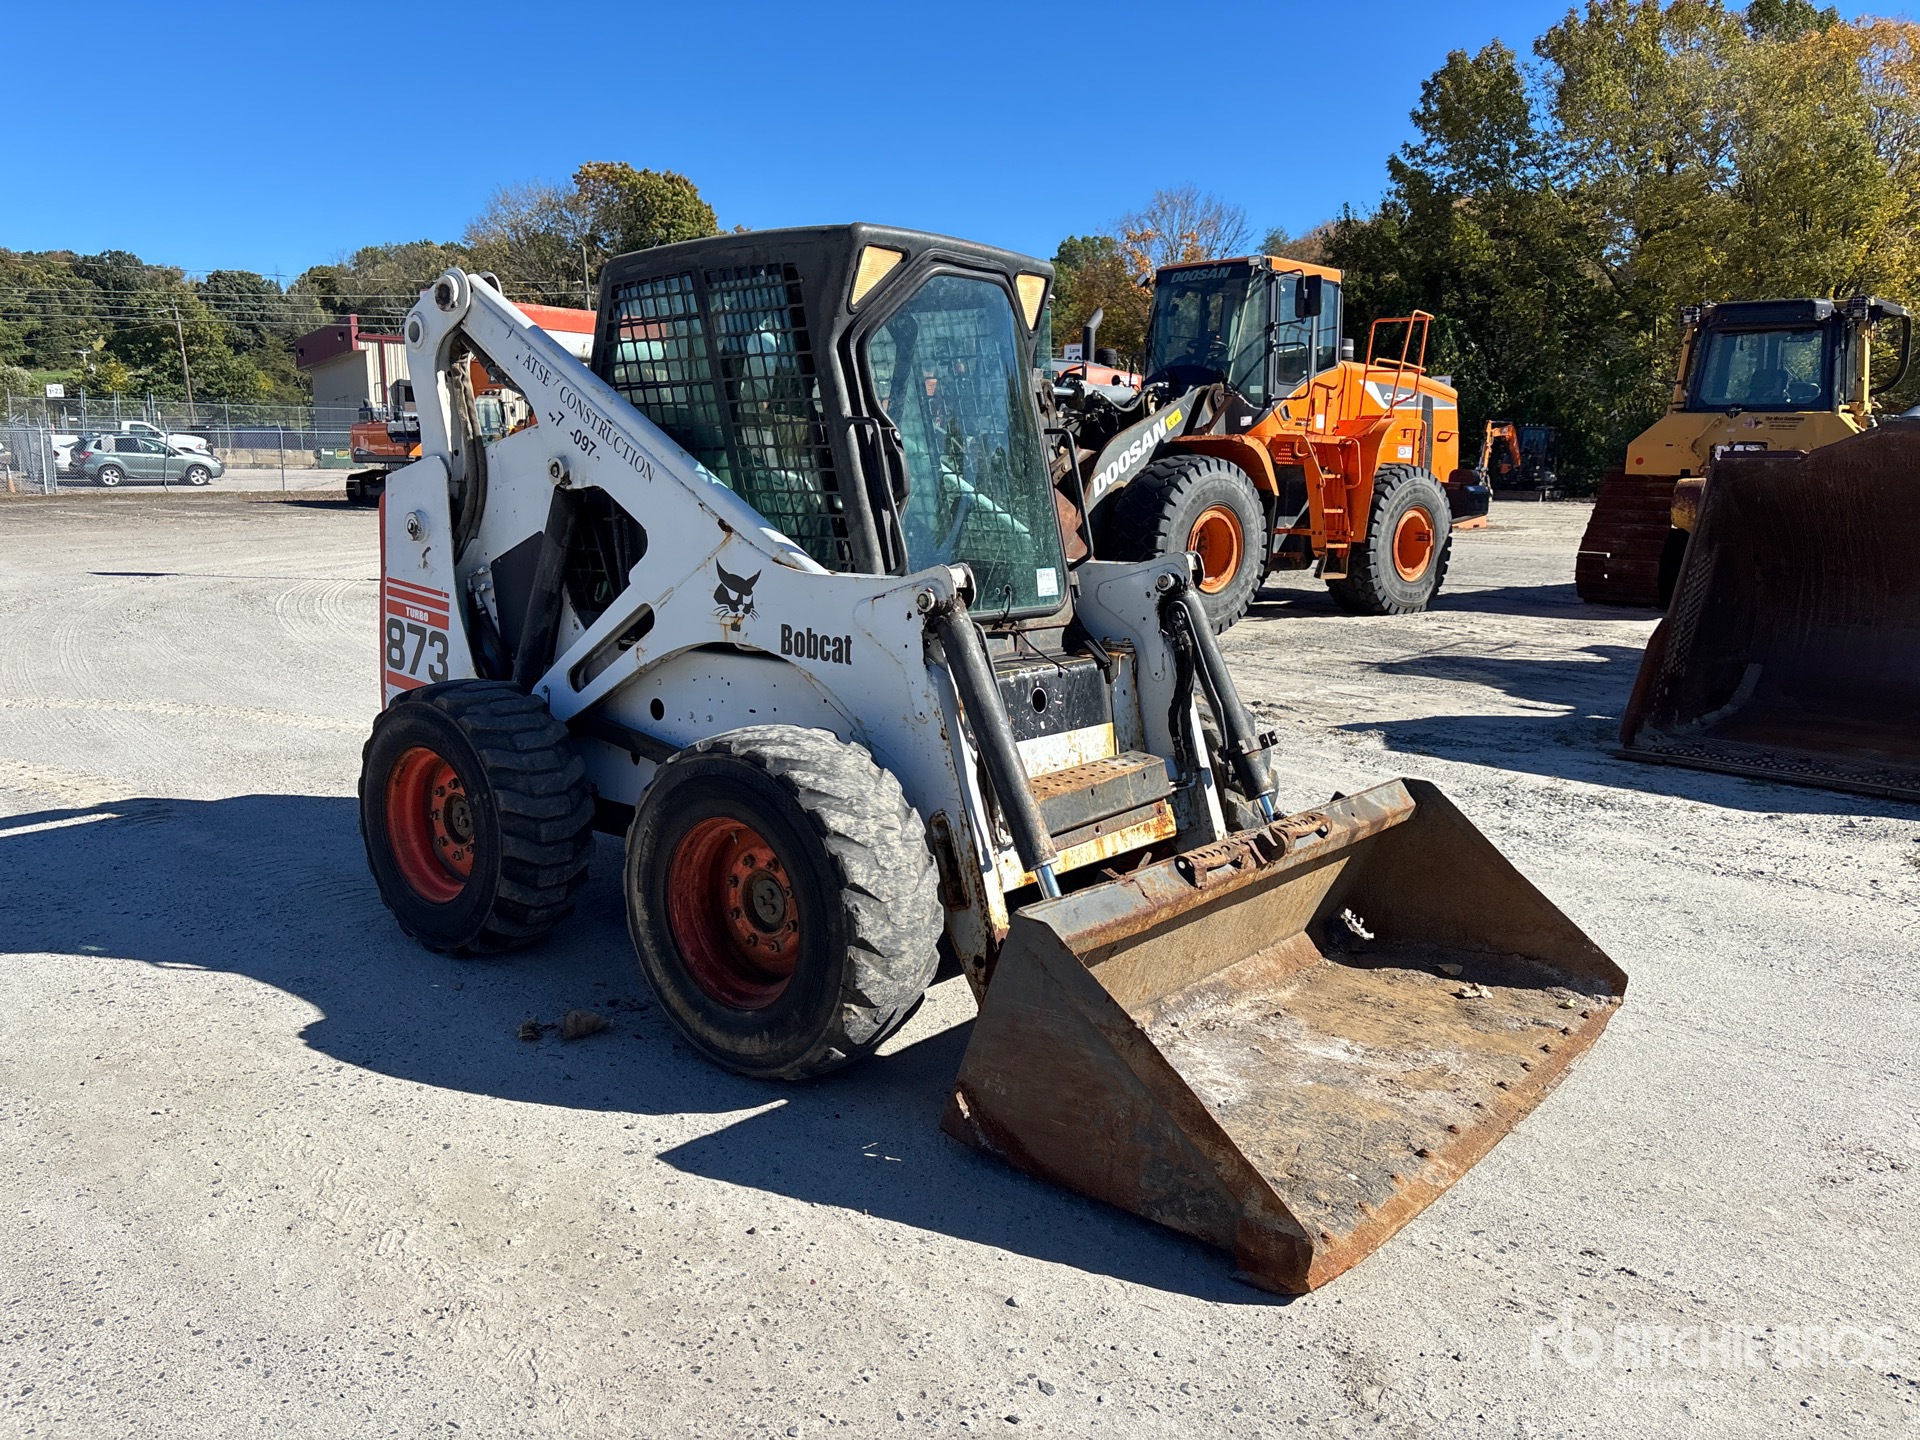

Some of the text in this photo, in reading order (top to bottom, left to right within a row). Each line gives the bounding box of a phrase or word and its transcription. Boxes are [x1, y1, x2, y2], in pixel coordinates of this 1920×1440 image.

[1170, 266, 1232, 284] DOOSAN
[559, 385, 656, 483] CONSTRUCTION
[569, 428, 600, 460] -097
[1092, 415, 1167, 499] DOOSAN
[405, 606, 429, 622] TURBO
[386, 617, 449, 684] 873
[780, 623, 853, 666] Bobcat
